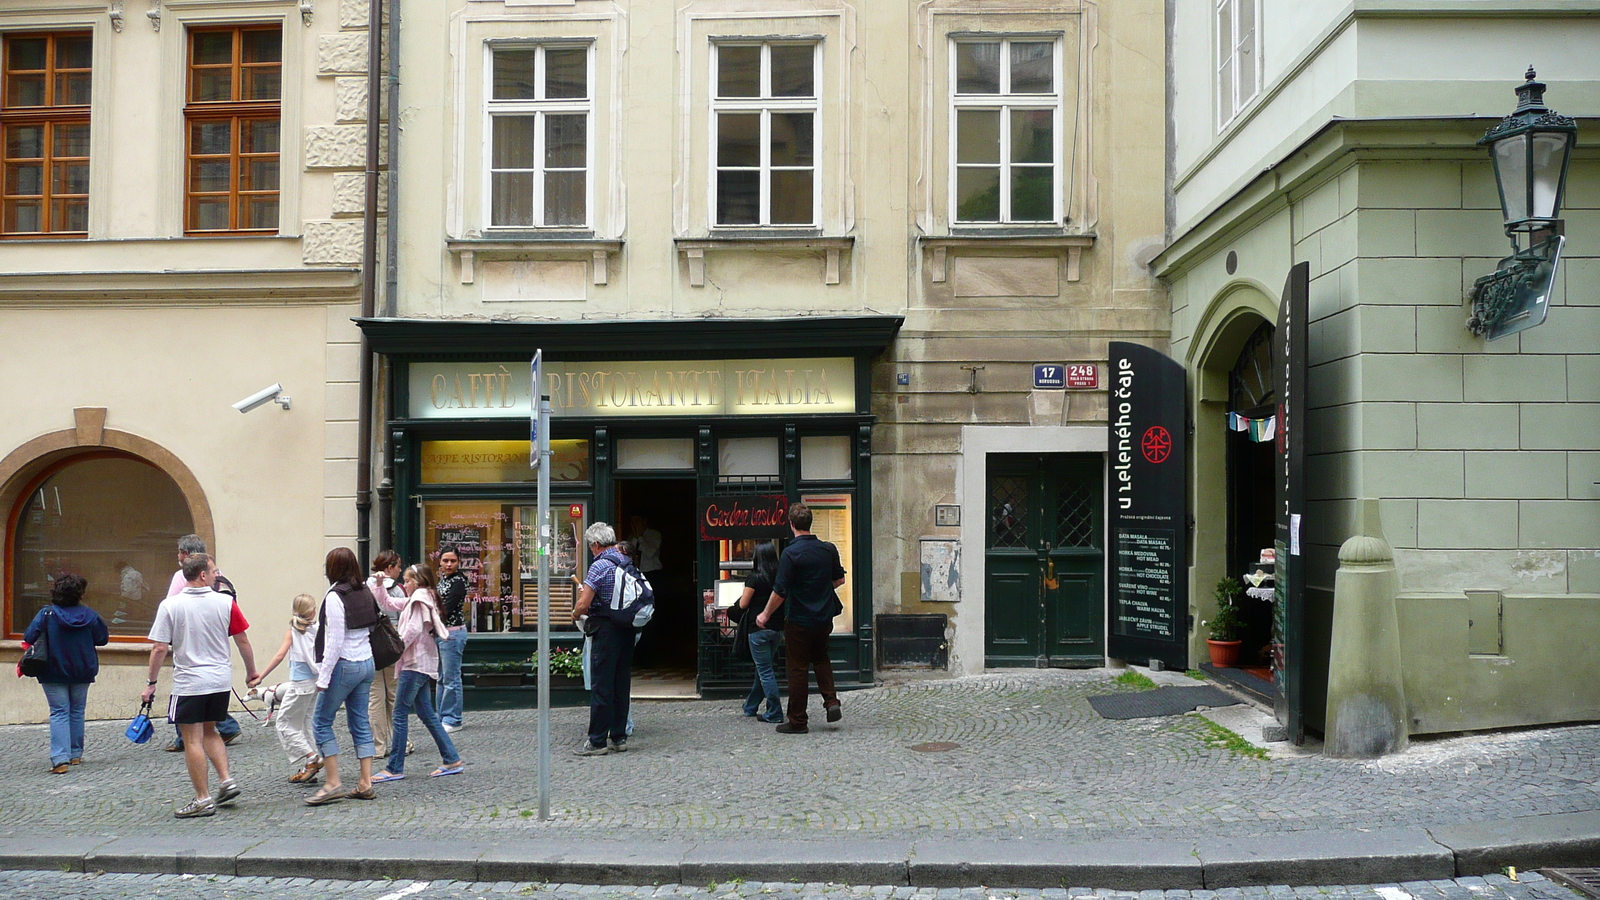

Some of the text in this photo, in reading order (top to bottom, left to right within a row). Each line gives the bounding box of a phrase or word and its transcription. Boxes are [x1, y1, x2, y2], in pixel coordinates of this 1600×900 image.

[1042, 367, 1056, 378] 17
[1070, 365, 1093, 376] 248
[430, 365, 834, 409] CAFFÈ RISTORANTE ITALIA
[1114, 358, 1135, 509] u zeleného čaje
[462, 453, 531, 464] RISTORANT
[706, 501, 749, 527] Garden
[751, 500, 786, 526] inside
